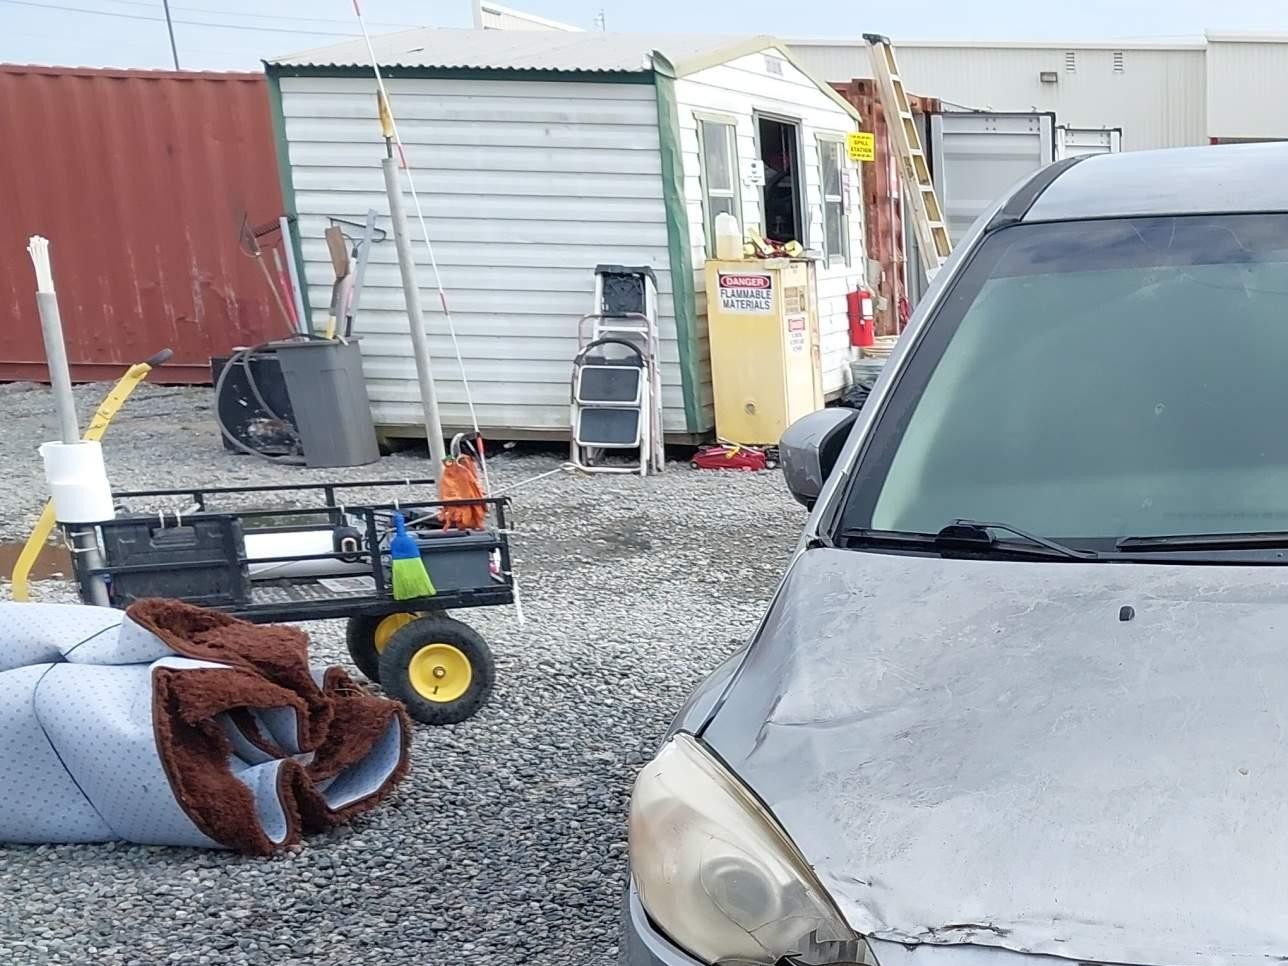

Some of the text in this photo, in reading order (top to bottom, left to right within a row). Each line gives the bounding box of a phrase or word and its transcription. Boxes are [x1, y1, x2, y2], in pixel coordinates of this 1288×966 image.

[726, 277, 764, 287] DANGER
[720, 288, 772, 300] FLAMMABLE
[722, 299, 770, 311] MATERIALS
